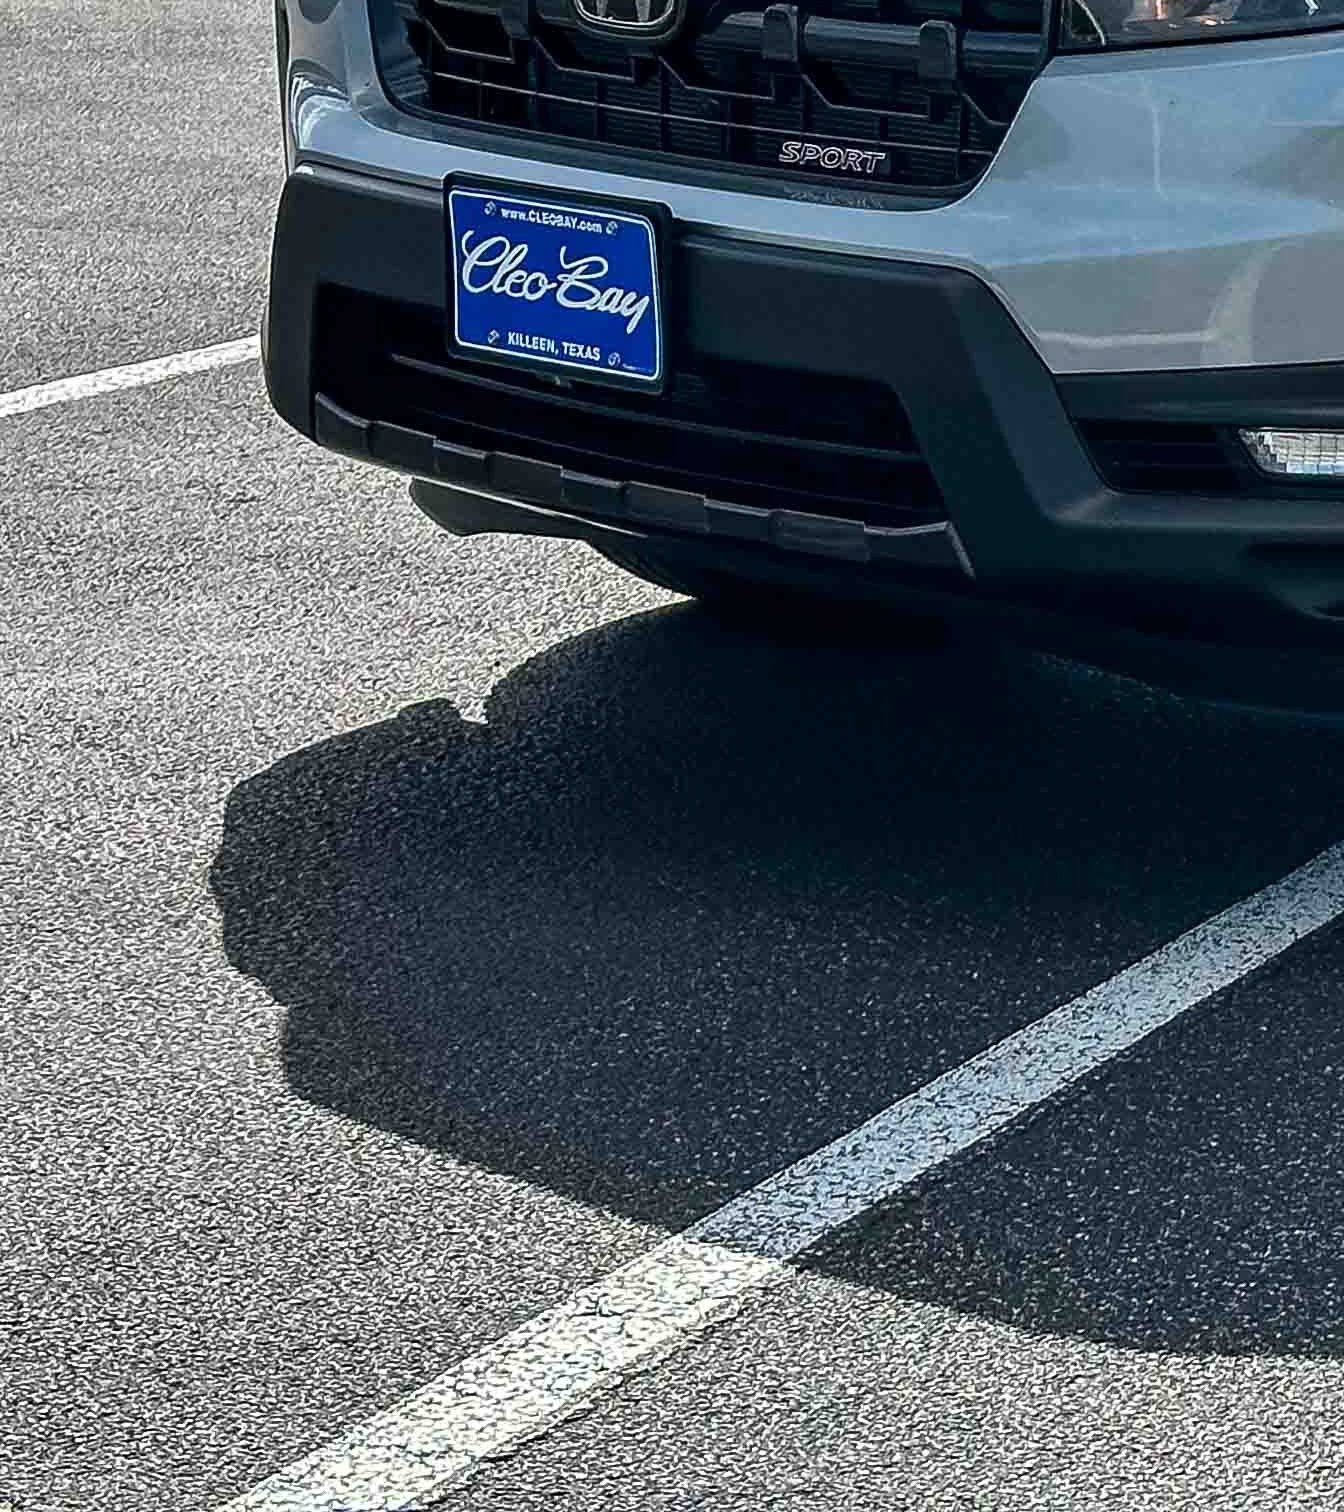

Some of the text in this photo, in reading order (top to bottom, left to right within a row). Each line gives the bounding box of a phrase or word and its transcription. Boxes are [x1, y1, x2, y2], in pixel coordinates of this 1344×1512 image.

[778, 141, 886, 174] SPORT
[500, 208, 603, 234] www.CLEOBAY.com
[461, 230, 650, 334] Cleo Bay
[507, 331, 601, 361] KILLEEN, TEXAS
